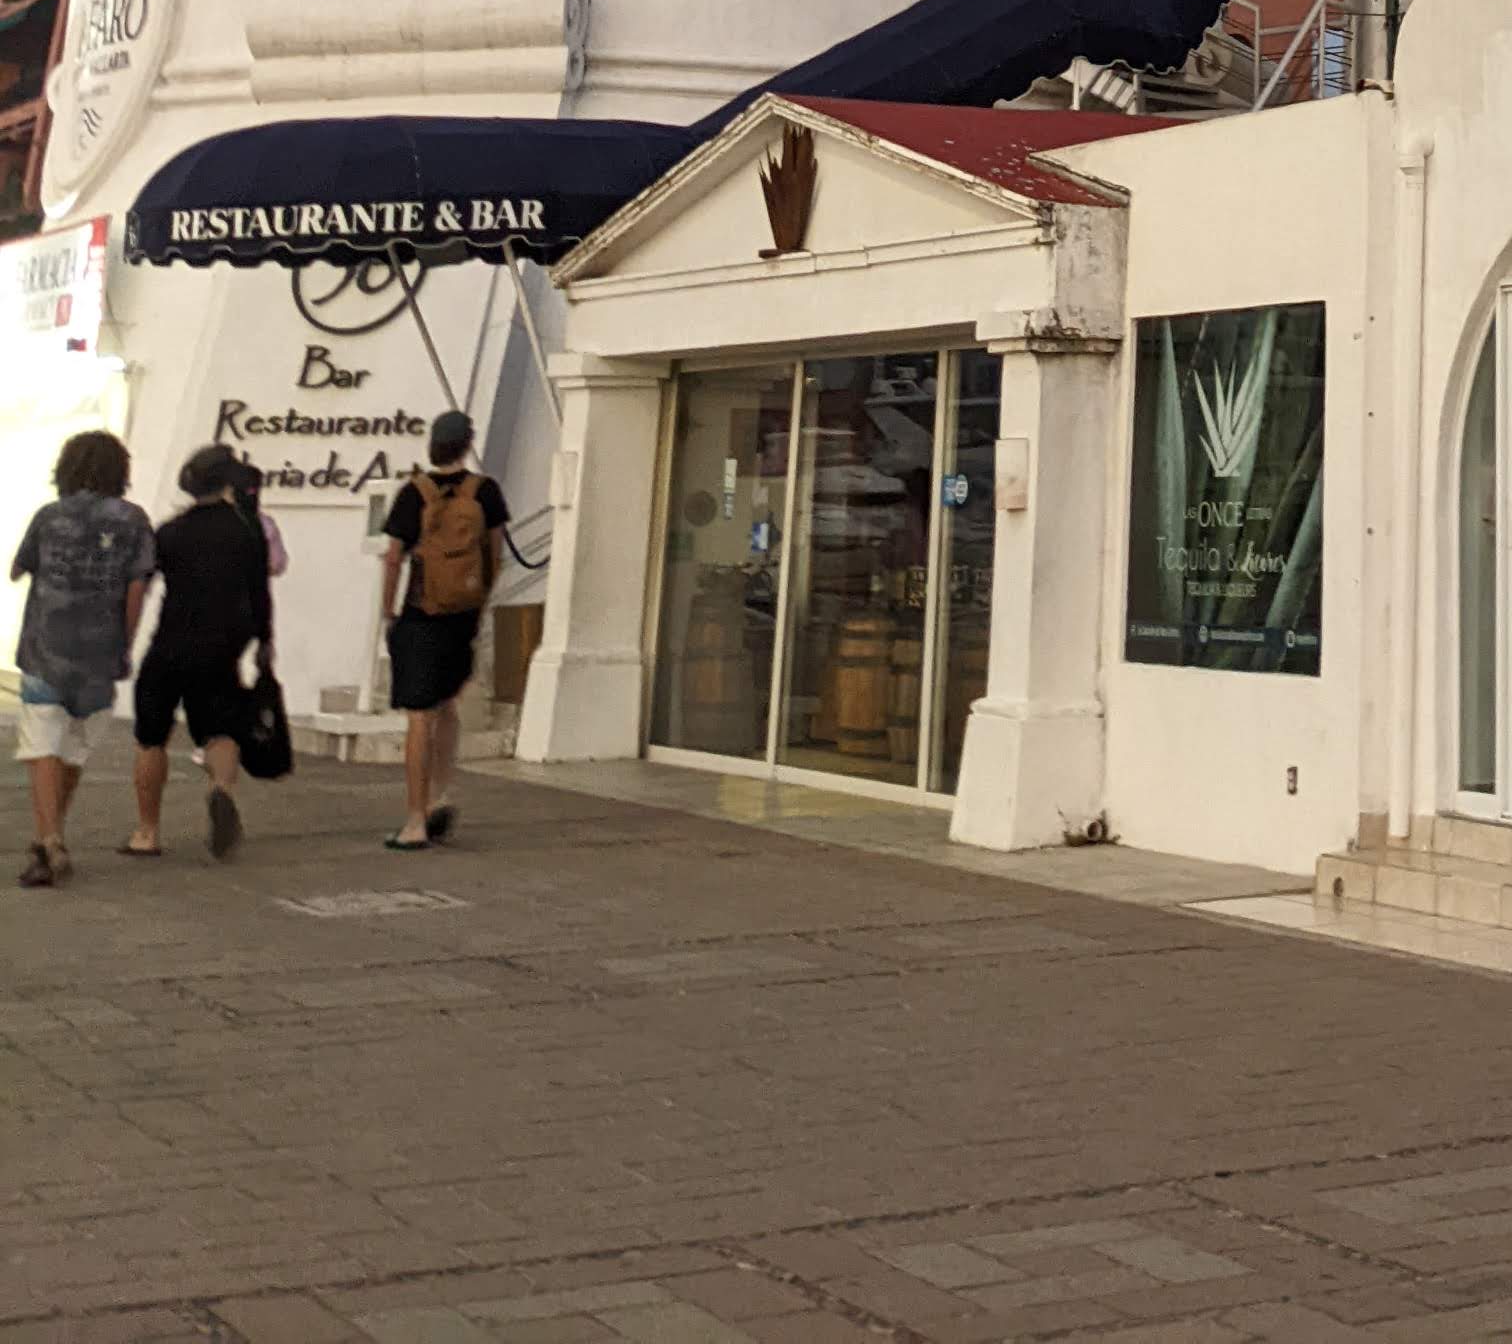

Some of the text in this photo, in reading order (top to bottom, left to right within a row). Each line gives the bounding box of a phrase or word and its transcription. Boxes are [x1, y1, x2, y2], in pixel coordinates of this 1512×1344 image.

[169, 201, 424, 242] RESTAURANTE
[434, 201, 463, 232] &
[470, 199, 545, 231] BAR
[297, 344, 372, 389] Bar
[213, 398, 426, 444] Restaurante
[309, 449, 350, 489] de
[1199, 501, 1244, 528] ONCE
[1155, 535, 1221, 578] Tequila
